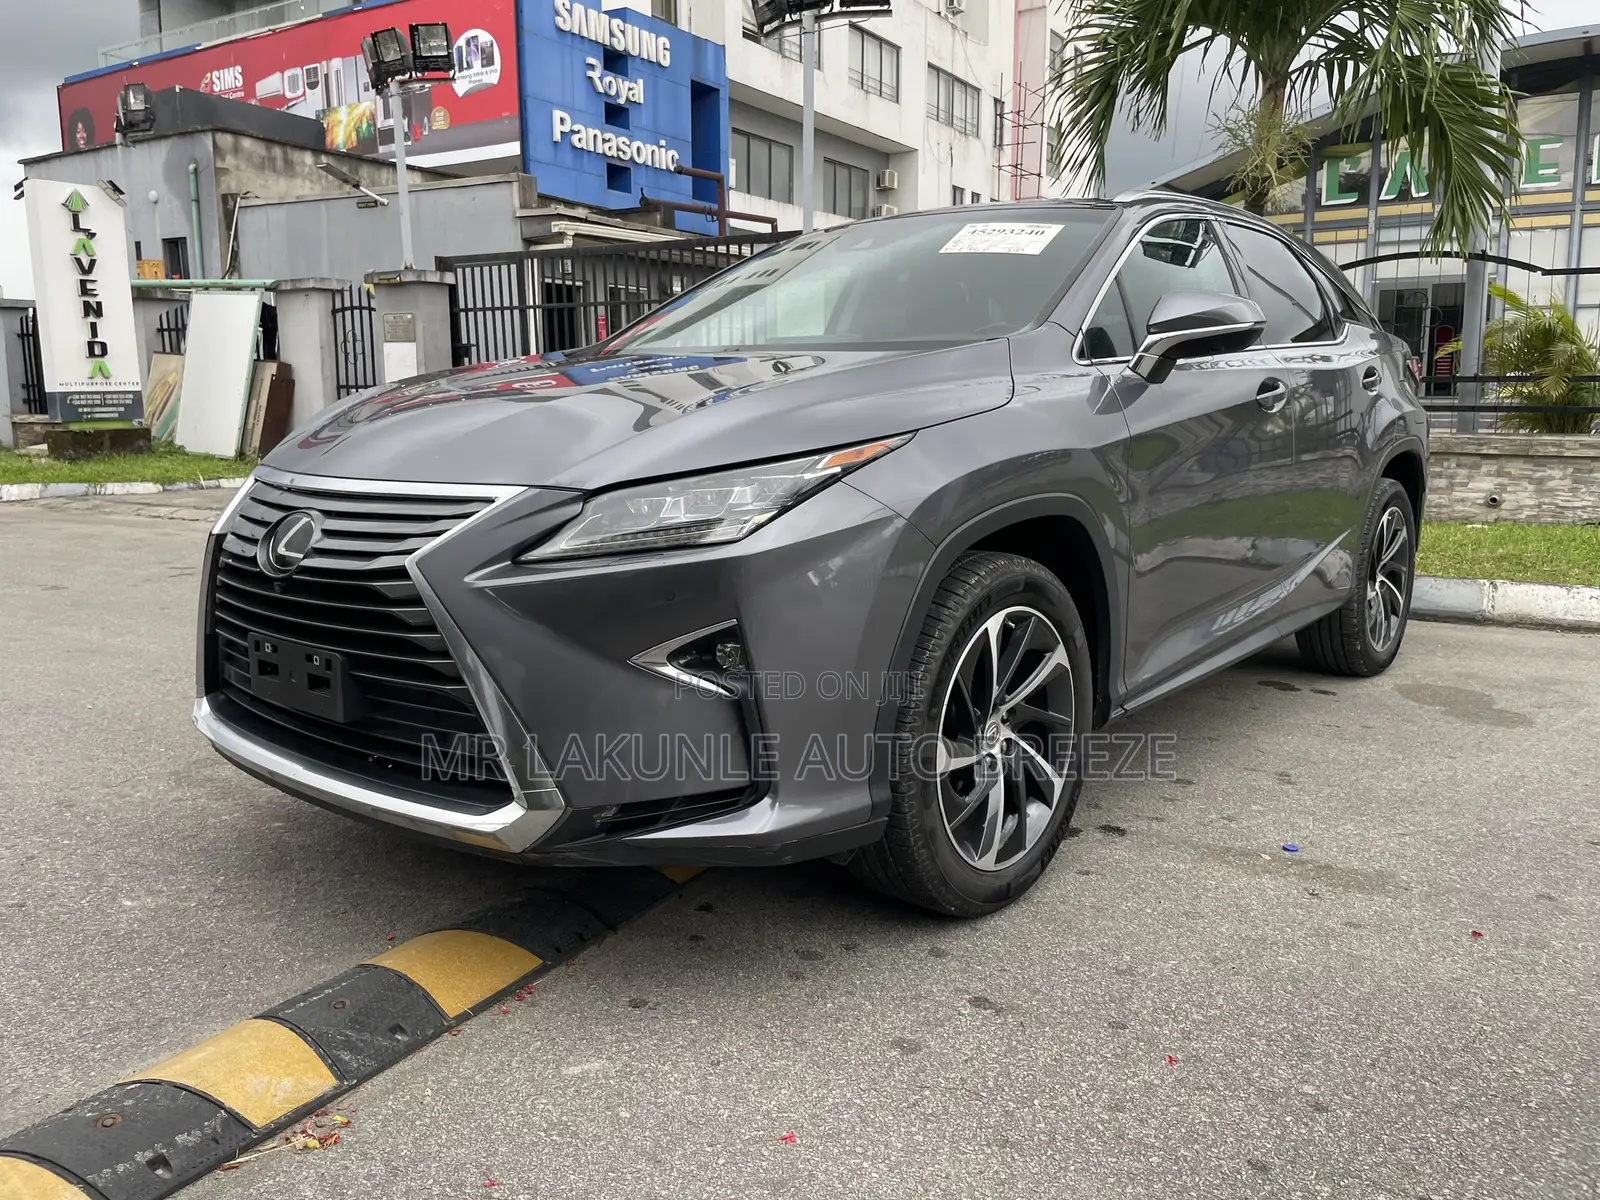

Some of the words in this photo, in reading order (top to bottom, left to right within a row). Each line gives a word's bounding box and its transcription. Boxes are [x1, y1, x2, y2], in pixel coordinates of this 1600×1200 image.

[554, 0, 671, 68] SAMSUNG
[212, 65, 244, 92] SIMS
[585, 57, 644, 105] Royal
[552, 109, 680, 172] Panasonic
